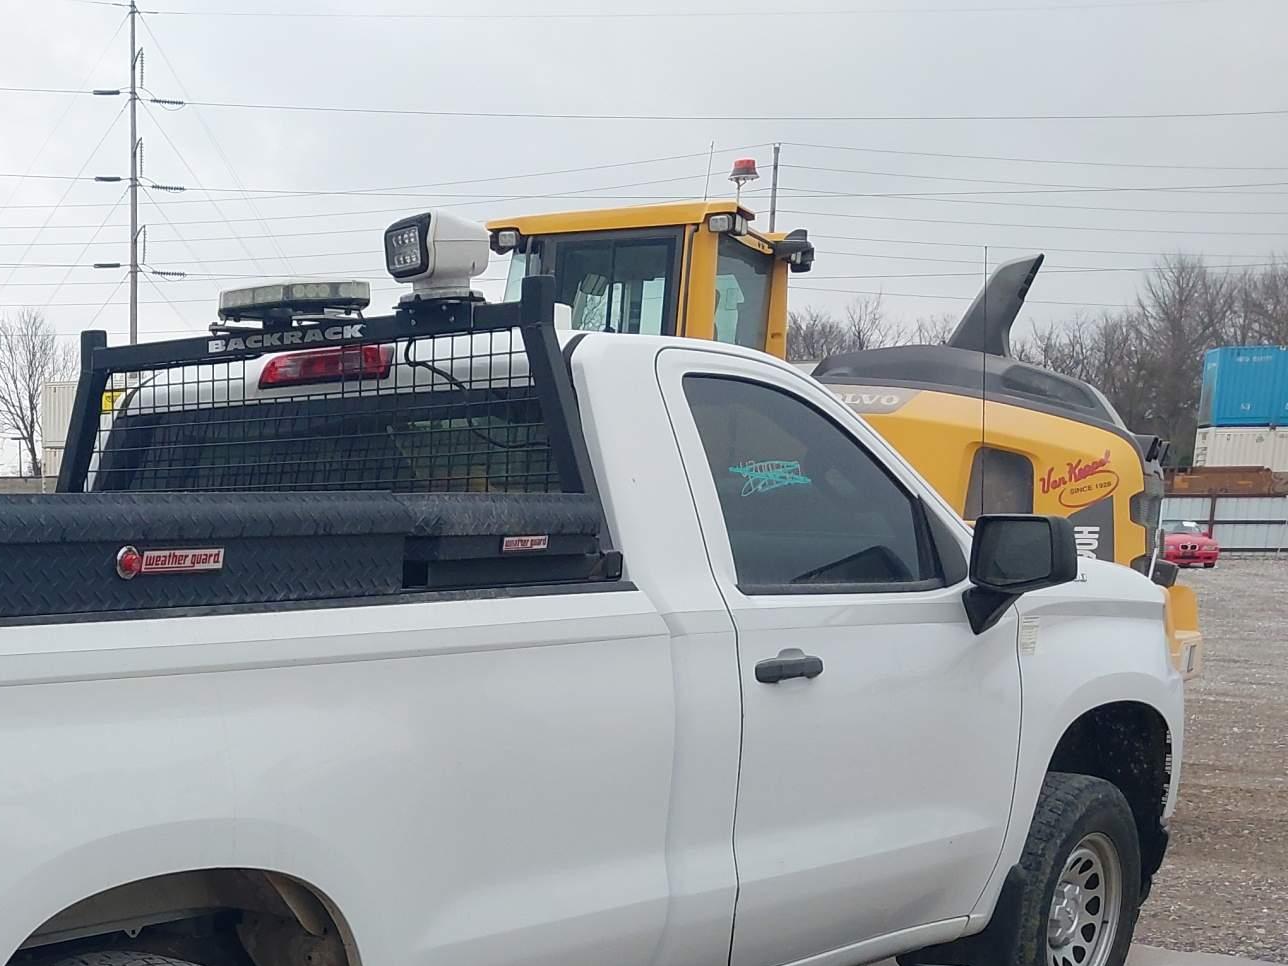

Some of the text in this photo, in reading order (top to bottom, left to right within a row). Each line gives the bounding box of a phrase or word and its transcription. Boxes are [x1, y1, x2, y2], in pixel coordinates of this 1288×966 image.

[208, 324, 363, 353] BACKRACK
[1039, 466, 1068, 495] Van
[1070, 485, 1093, 495] SINCE
[144, 550, 221, 568] weather guard
